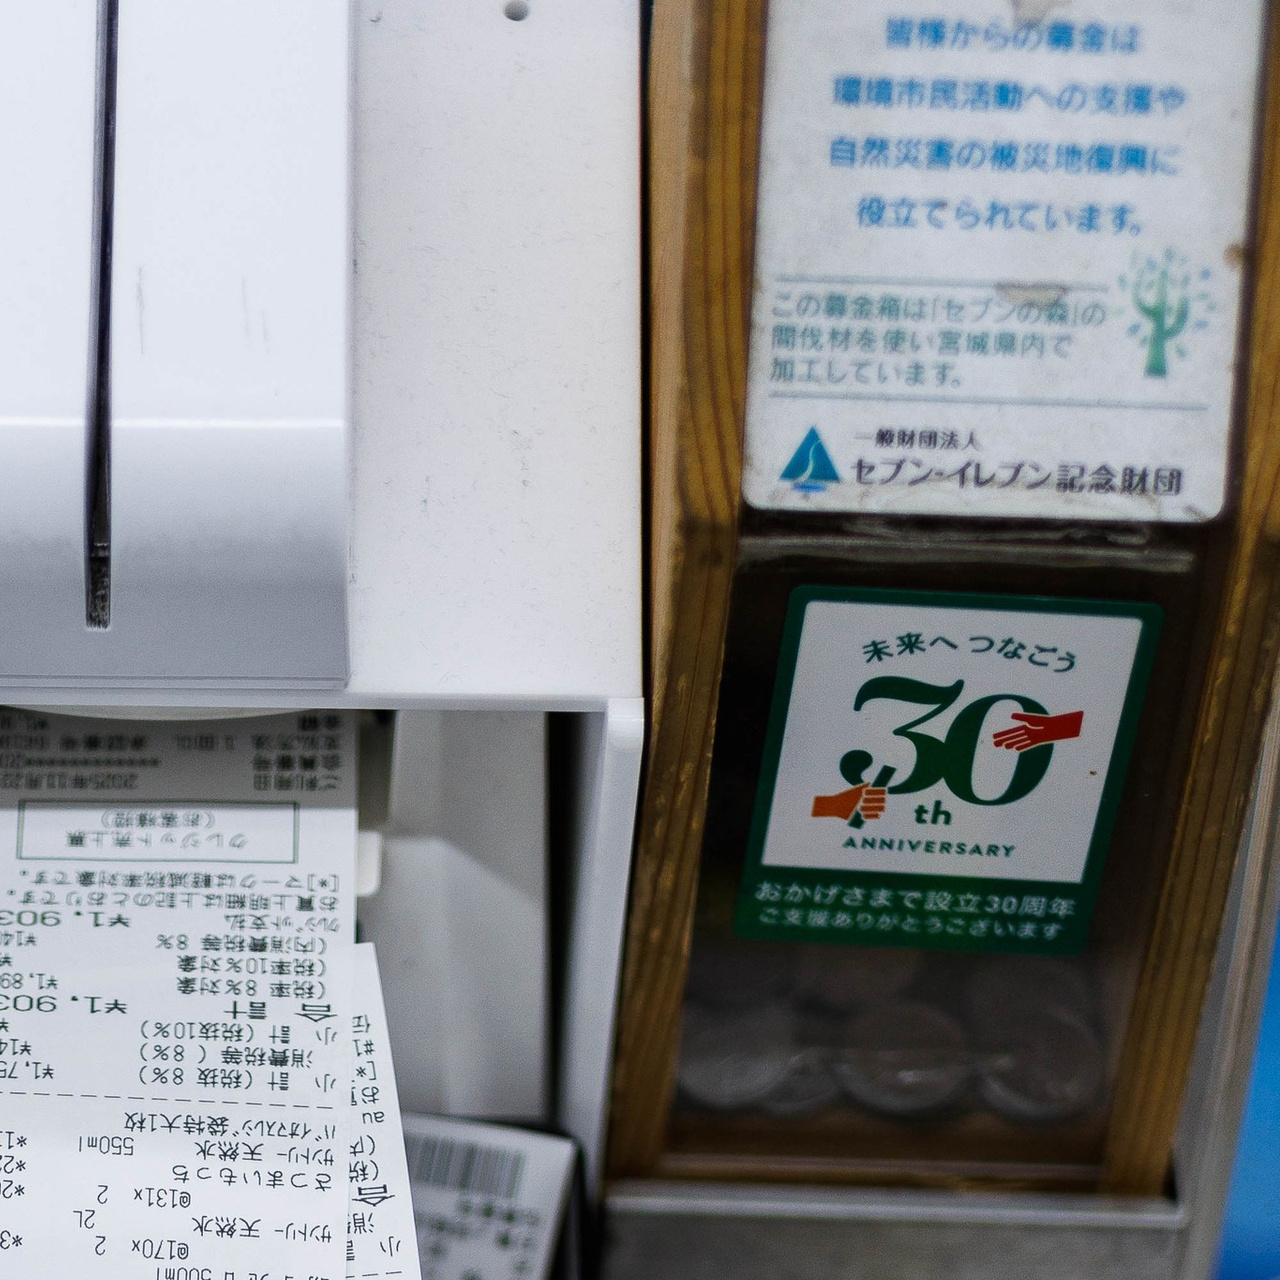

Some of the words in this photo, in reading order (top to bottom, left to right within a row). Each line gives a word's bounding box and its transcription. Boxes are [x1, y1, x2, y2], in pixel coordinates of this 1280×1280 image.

[854, 427, 980, 452] 一般財団法人
[863, 633, 1077, 672] 未来へつなごう
[839, 676, 1055, 806] 30
[915, 801, 952, 826] th
[842, 836, 1016, 857] ANNIVERSARY
[79, 1135, 134, 1155] 550ml
[194, 1140, 263, 1162] 天然水
[277, 1146, 334, 1167] サントリー
[171, 1164, 333, 1192] さつまいもっち
[97, 1186, 108, 1203] 2
[73, 1210, 95, 1228] 2L
[191, 1215, 261, 1238] 天然水
[274, 1221, 332, 1243] サントリー
[95, 1236, 105, 1254] 2
